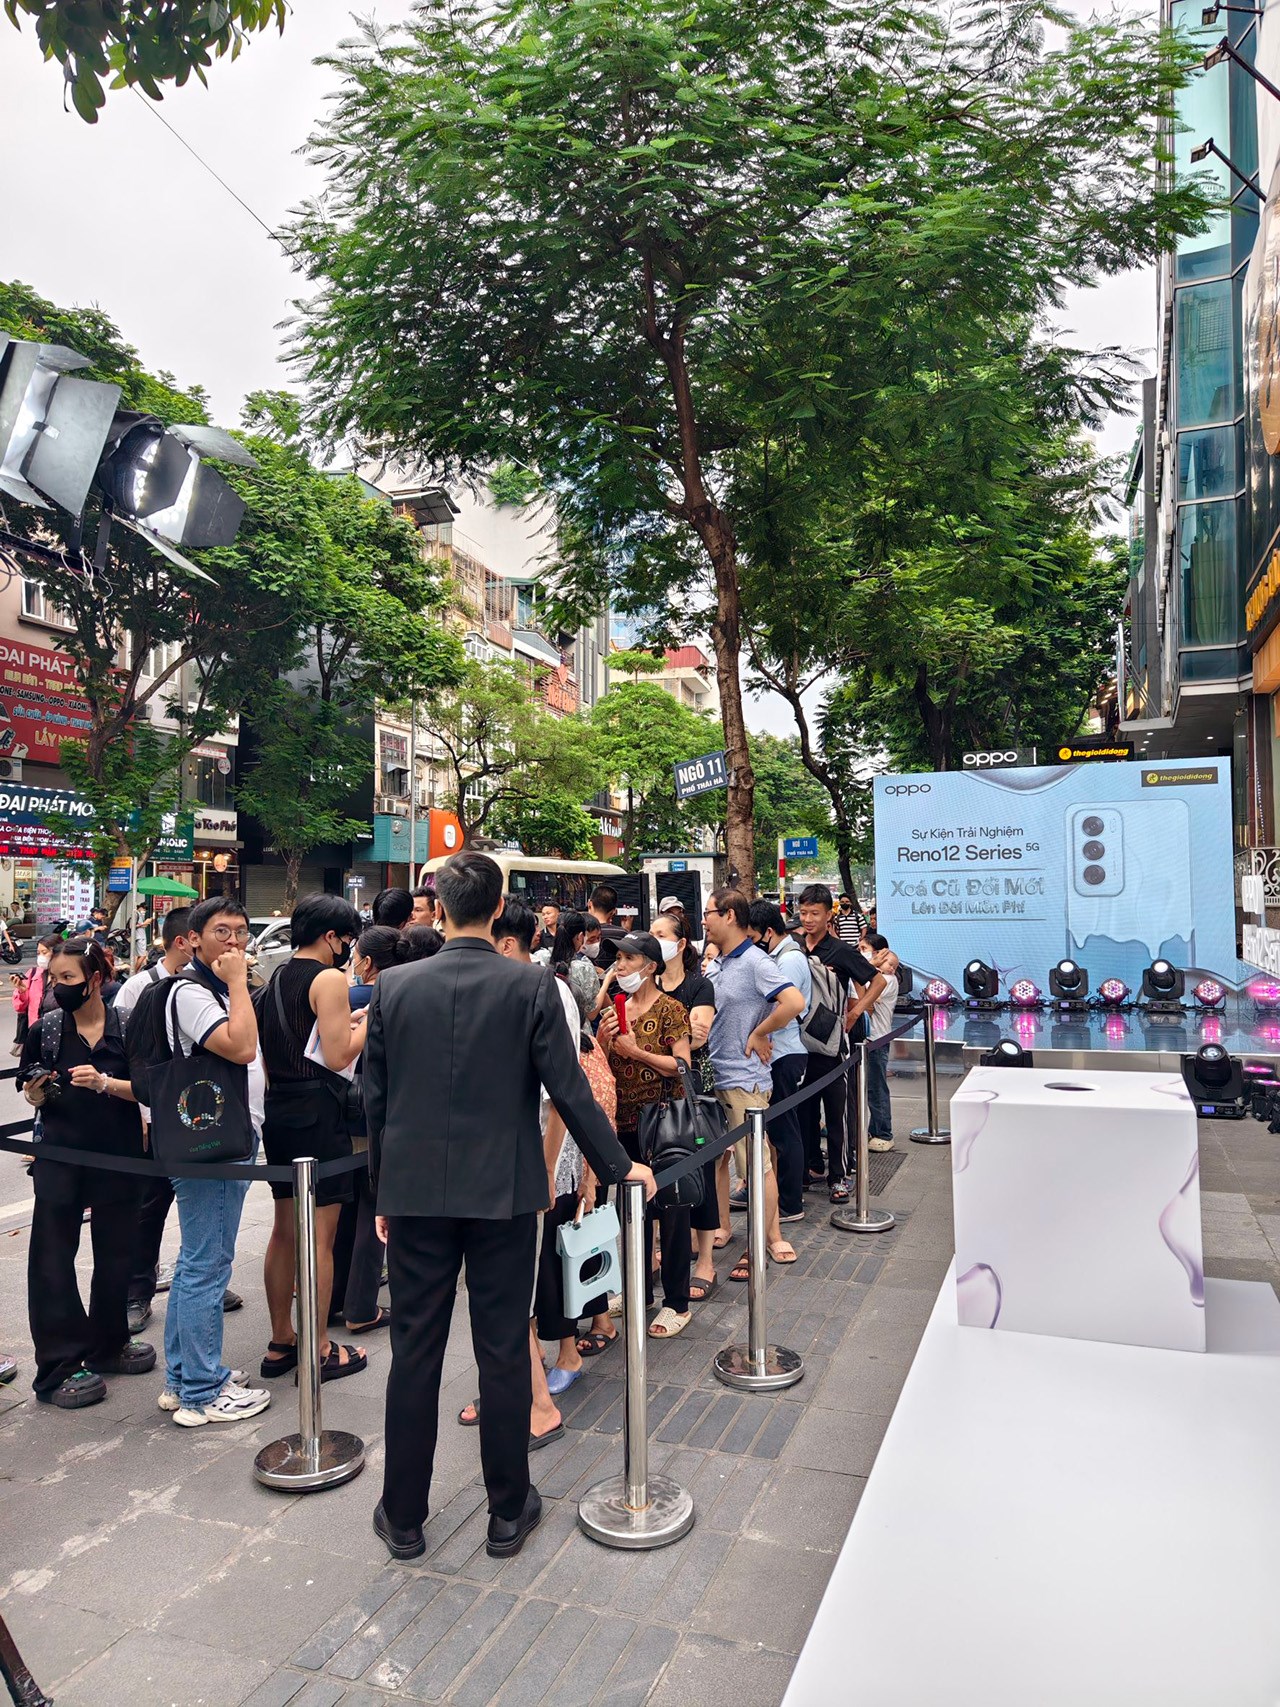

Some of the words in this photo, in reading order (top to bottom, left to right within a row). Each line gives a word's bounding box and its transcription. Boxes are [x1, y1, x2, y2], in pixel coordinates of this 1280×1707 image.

[29, 653, 71, 676] PHÁT
[16, 689, 45, 703] SAMSUNG
[48, 696, 66, 708] OPPO
[34, 727, 57, 748] LẤY
[963, 751, 1018, 766] oppo
[1073, 748, 1129, 758] thegioididong
[678, 760, 705, 785] NGÕ
[706, 757, 722, 776] 11
[1159, 773, 1213, 783] thegioididong
[681, 784, 696, 794] PHỐ
[696, 780, 713, 790] THÁI
[713, 776, 724, 786] HÀ
[885, 783, 932, 797] oppo
[0, 794, 27, 815] ĐẠI
[29, 795, 68, 814] PHÁT
[911, 829, 928, 841] Sự
[930, 828, 954, 840] Kiện
[957, 826, 977, 838] Trải
[979, 826, 1024, 839] Nghiệm
[897, 846, 961, 862] Reno12
[965, 844, 1022, 861] Series
[1026, 842, 1040, 851] 5G
[890, 879, 928, 896] Xoá
[932, 878, 960, 896] Cũ
[966, 876, 1000, 896] Đổi
[1004, 876, 1044, 896] Mới
[911, 900, 936, 914] Lên
[1002, 900, 1026, 913] Phí
